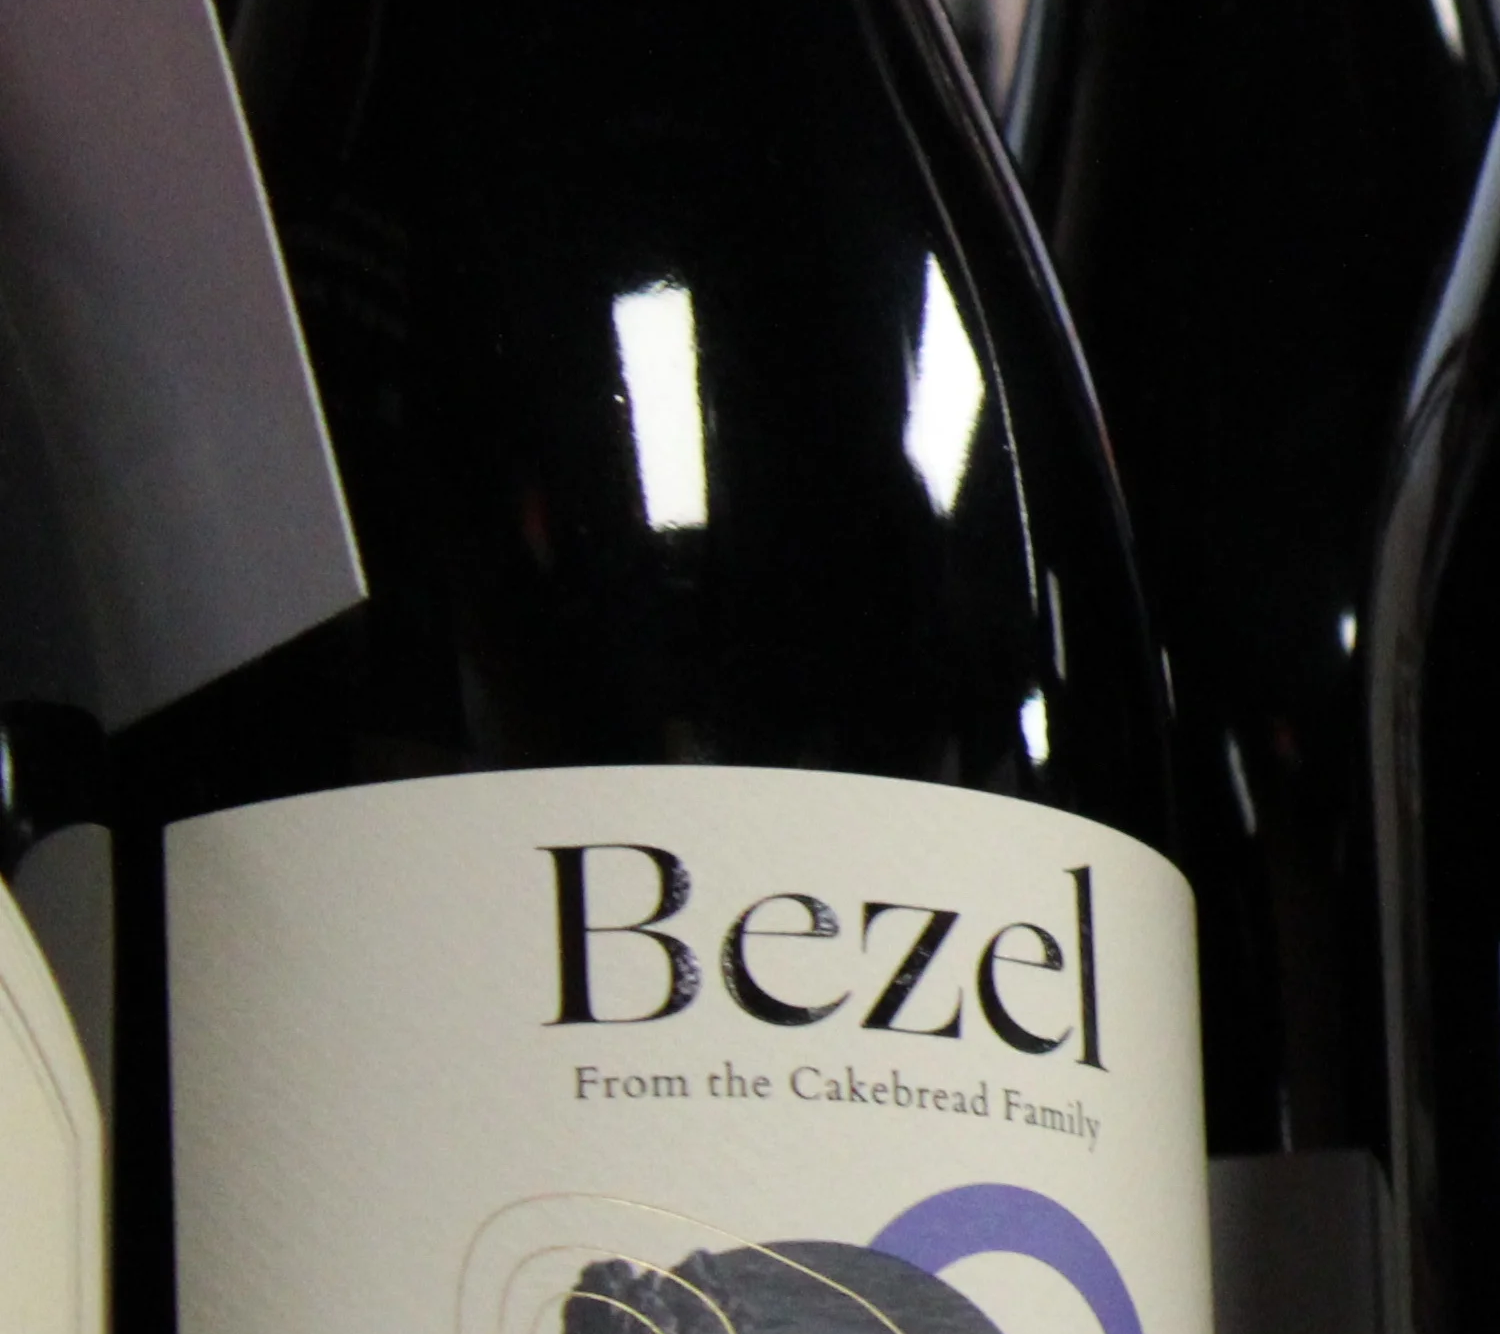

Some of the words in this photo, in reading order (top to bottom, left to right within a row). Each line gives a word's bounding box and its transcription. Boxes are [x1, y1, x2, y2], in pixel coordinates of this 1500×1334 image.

[536, 842, 1109, 1073] Bezel
[574, 1065, 690, 1100] From
[707, 1061, 773, 1100] the
[789, 1065, 990, 1118] Cakebread
[1001, 1088, 1101, 1152] Family
